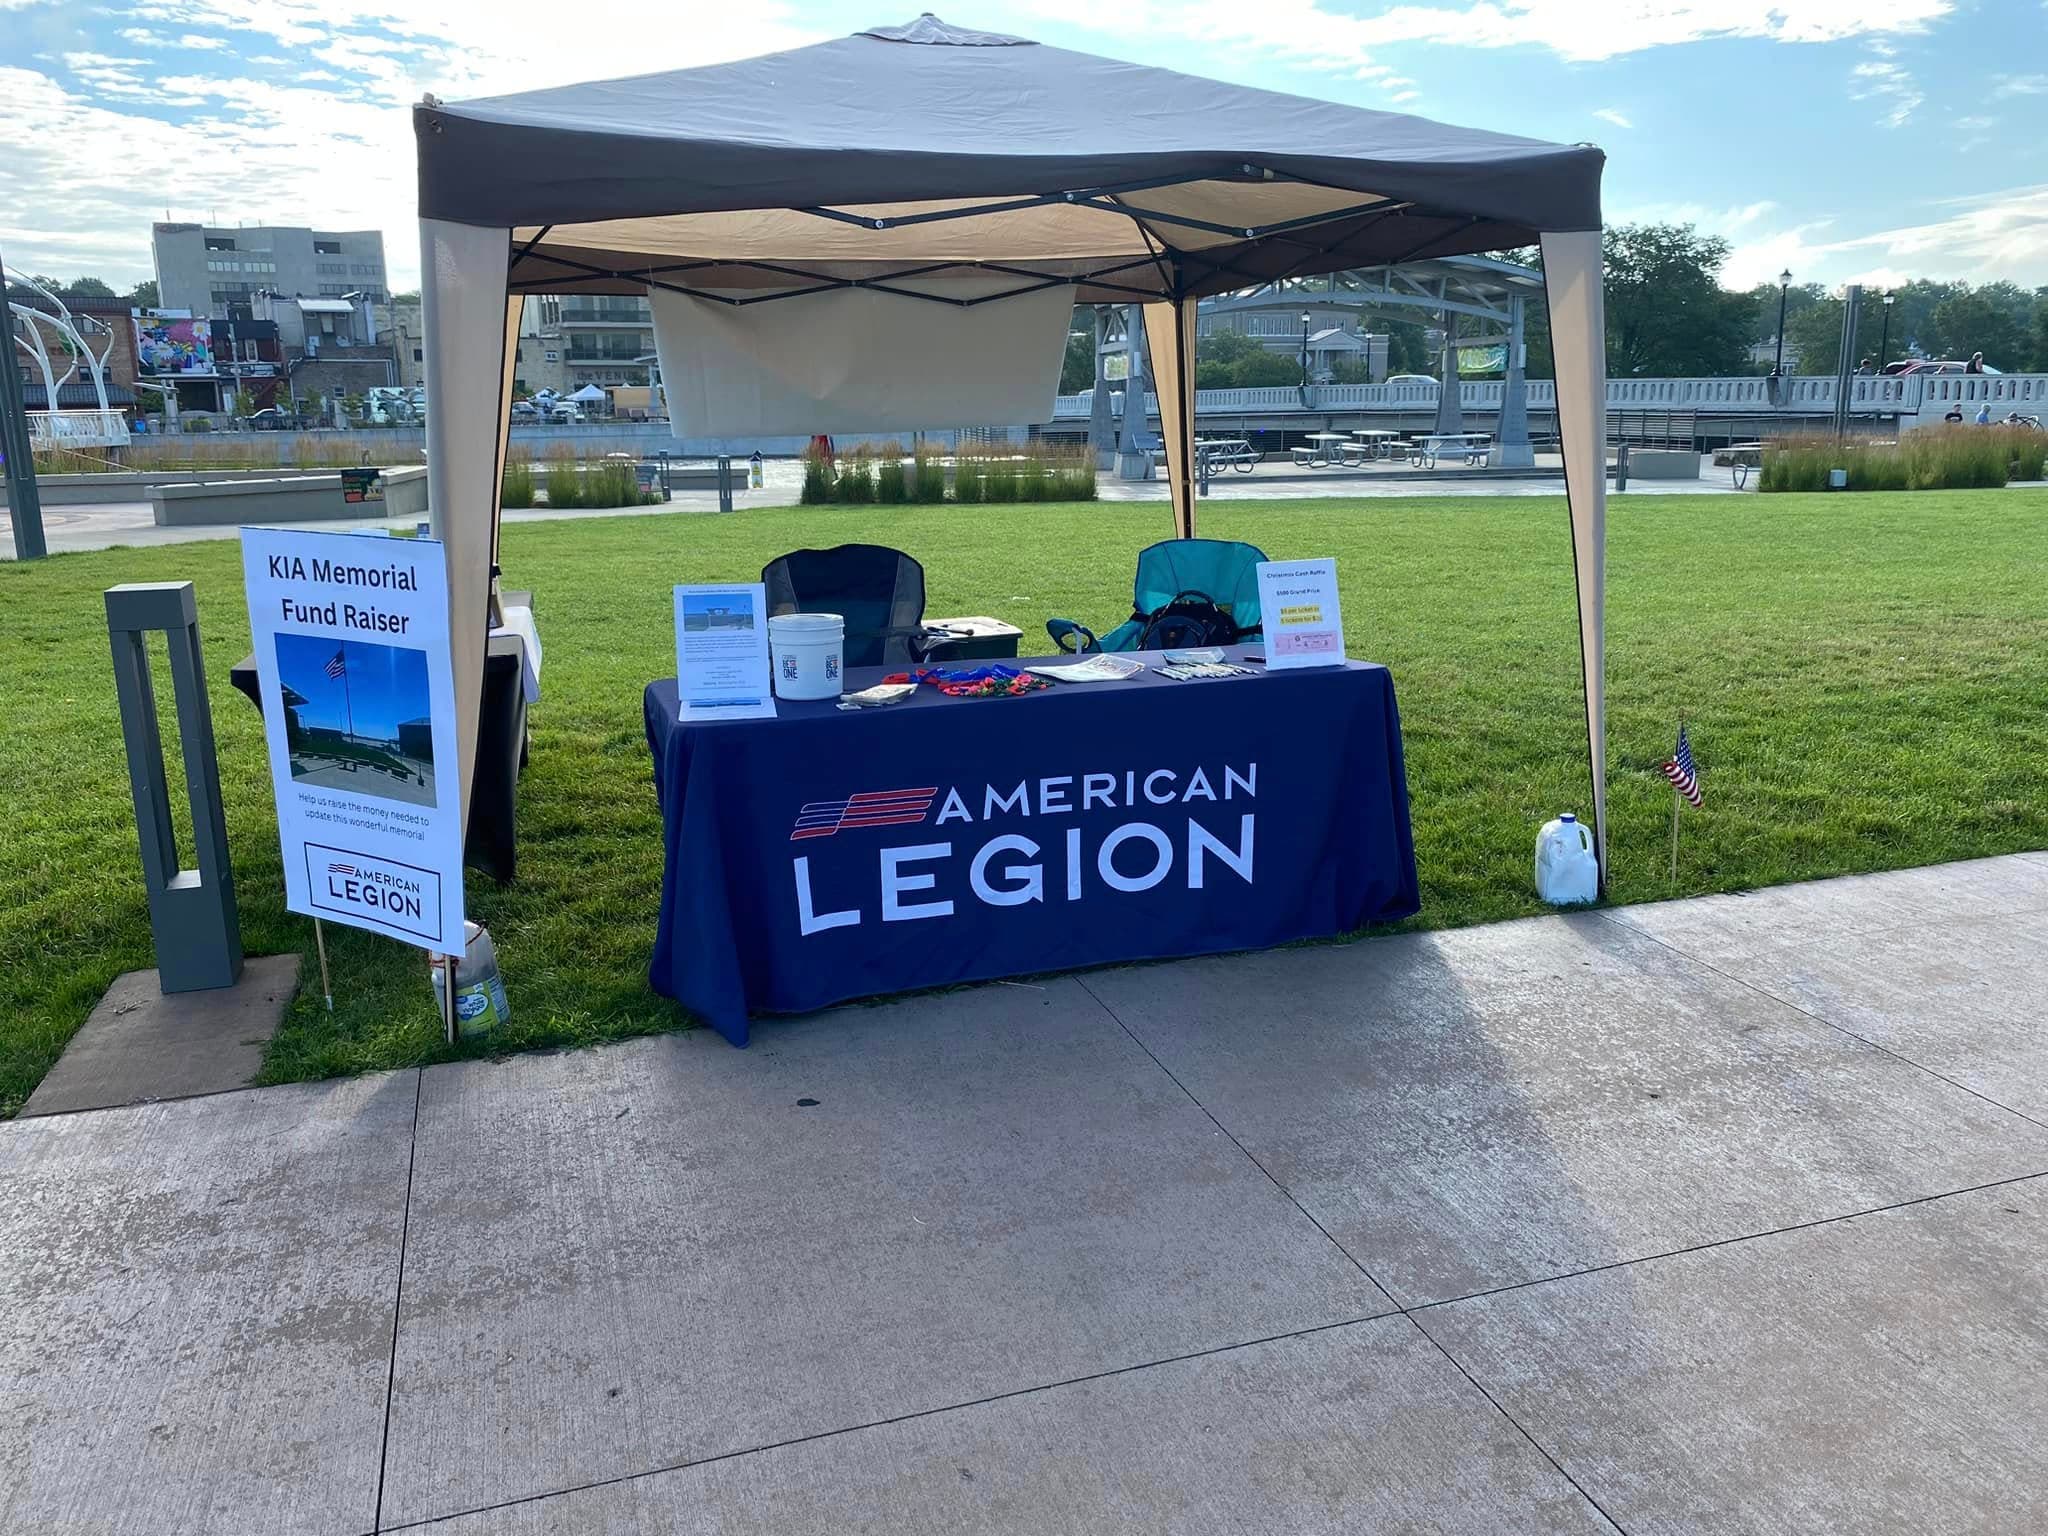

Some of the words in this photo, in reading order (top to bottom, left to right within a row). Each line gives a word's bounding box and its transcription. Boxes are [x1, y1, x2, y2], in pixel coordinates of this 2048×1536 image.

[268, 555, 307, 581] KIA
[312, 558, 418, 591] Memorial
[281, 598, 338, 626] Fund
[343, 604, 410, 634] Raiser
[783, 669, 798, 679] ONE
[826, 669, 838, 679] ONE
[299, 793, 316, 804] Help
[317, 798, 327, 806] us
[328, 800, 347, 810] raise
[348, 801, 362, 812] the
[363, 806, 389, 820] money
[390, 811, 419, 824] needed
[420, 816, 430, 826] to
[935, 762, 1257, 825] AMERICAN
[305, 809, 333, 822] update
[333, 812, 348, 825] this
[349, 818, 389, 833] wonderful
[389, 825, 425, 840] memorial
[354, 868, 420, 894] AMERICAN
[793, 814, 1255, 936] LEGION
[328, 875, 421, 920] LEGION
